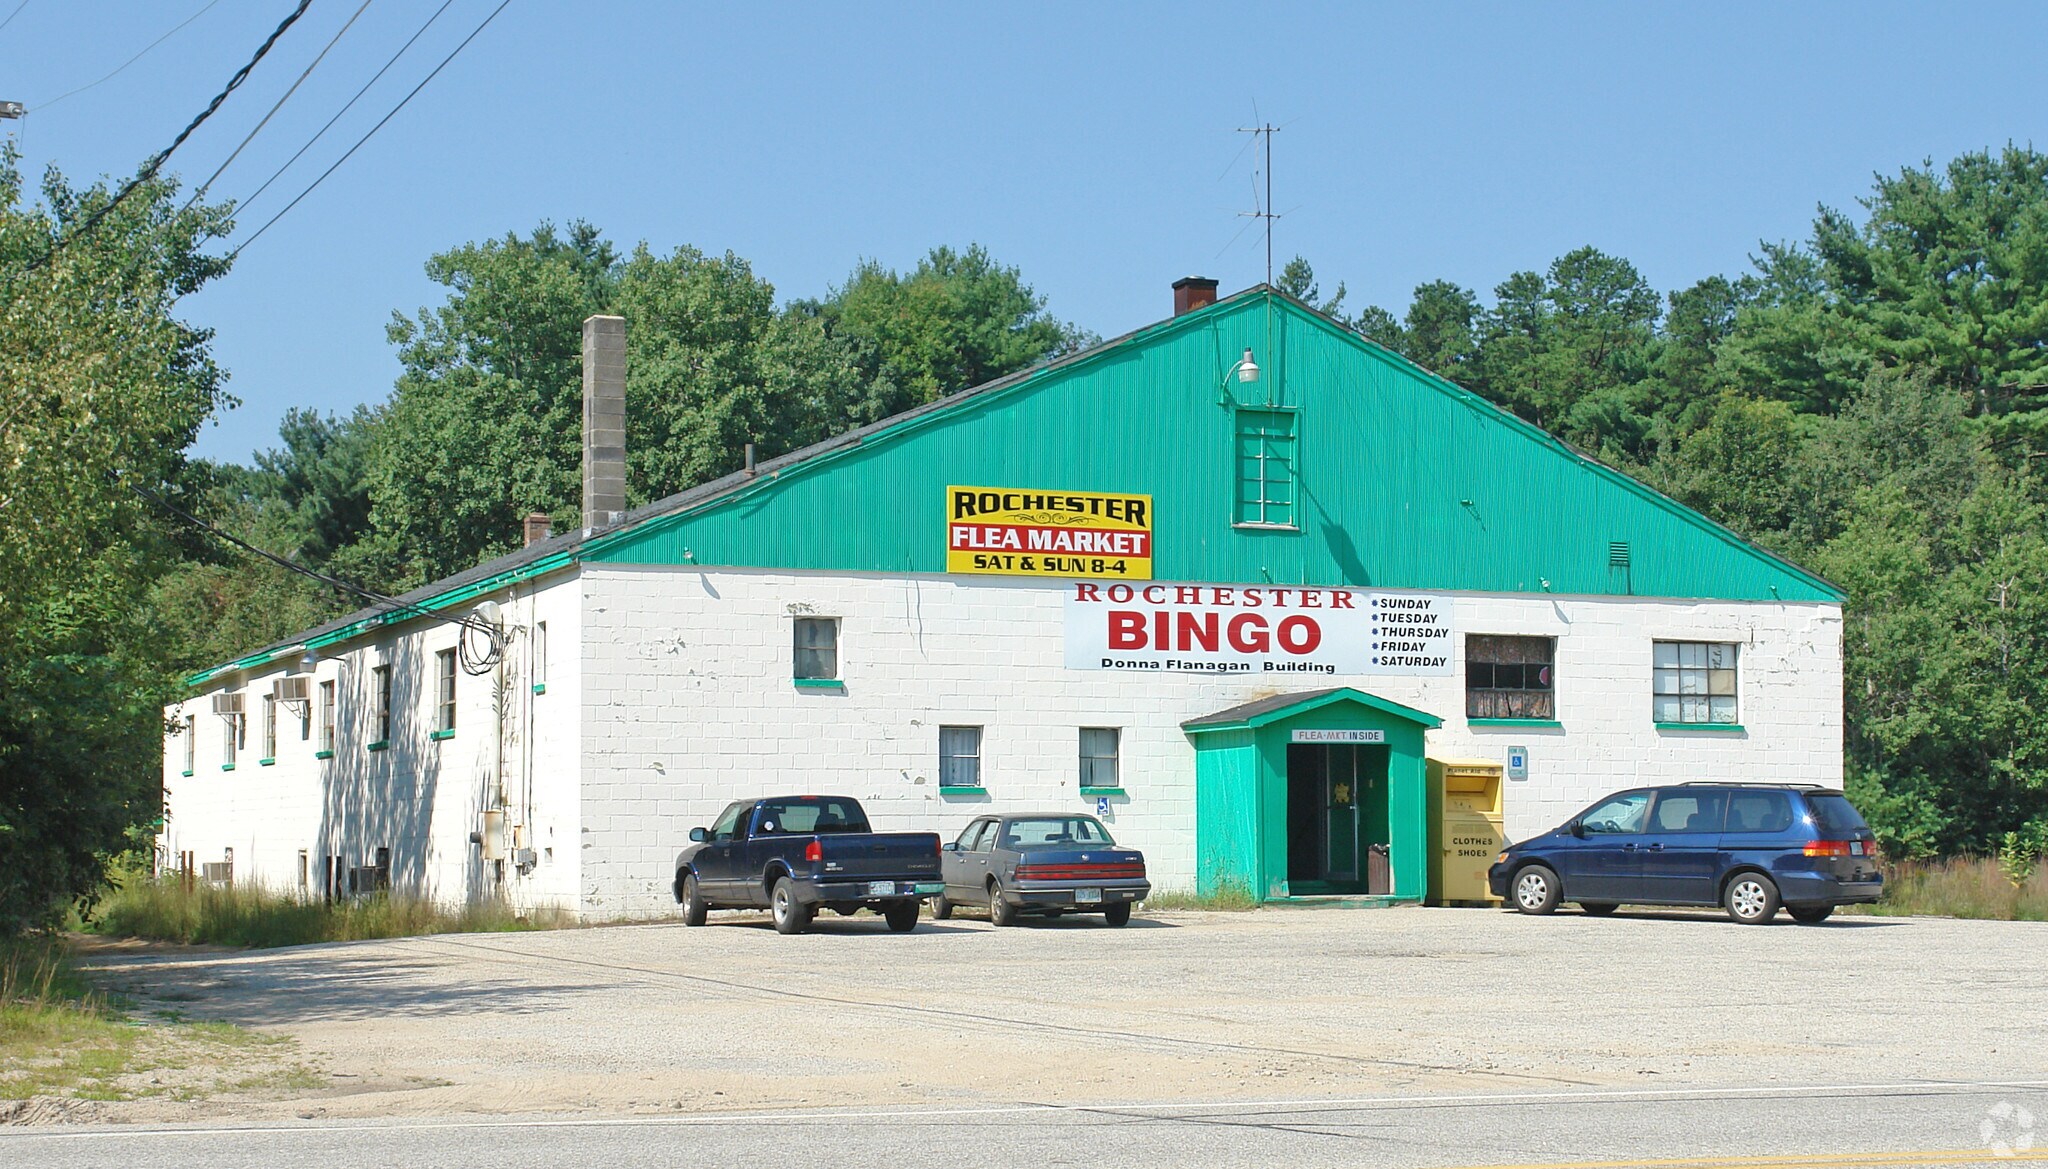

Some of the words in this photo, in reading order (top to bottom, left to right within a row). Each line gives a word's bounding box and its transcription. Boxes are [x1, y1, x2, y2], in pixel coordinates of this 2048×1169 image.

[954, 491, 1146, 528] ROCHESTER
[952, 526, 1022, 549] FLEA
[1027, 529, 1145, 554] MARKET
[974, 554, 1015, 570] SAT
[1020, 556, 1036, 570] &
[1043, 557, 1085, 572] SUN
[1091, 559, 1126, 574] 8-4
[1074, 582, 1356, 609] ROCHESTER
[1380, 598, 1431, 609] SUNDAY
[1380, 613, 1438, 624] TUESDAY
[1108, 610, 1322, 655] BINGO
[1381, 627, 1449, 638] THURSDAY
[1381, 641, 1426, 652] FRIDAY
[1101, 658, 1160, 669] Donna
[1166, 659, 1250, 672] Flanagan
[1263, 661, 1335, 674] Building
[1380, 655, 1447, 667] SATURDAY
[1349, 731, 1379, 740] INSIDE
[1452, 837, 1493, 845] CLOTHES
[1458, 849, 1487, 857] SHOES
